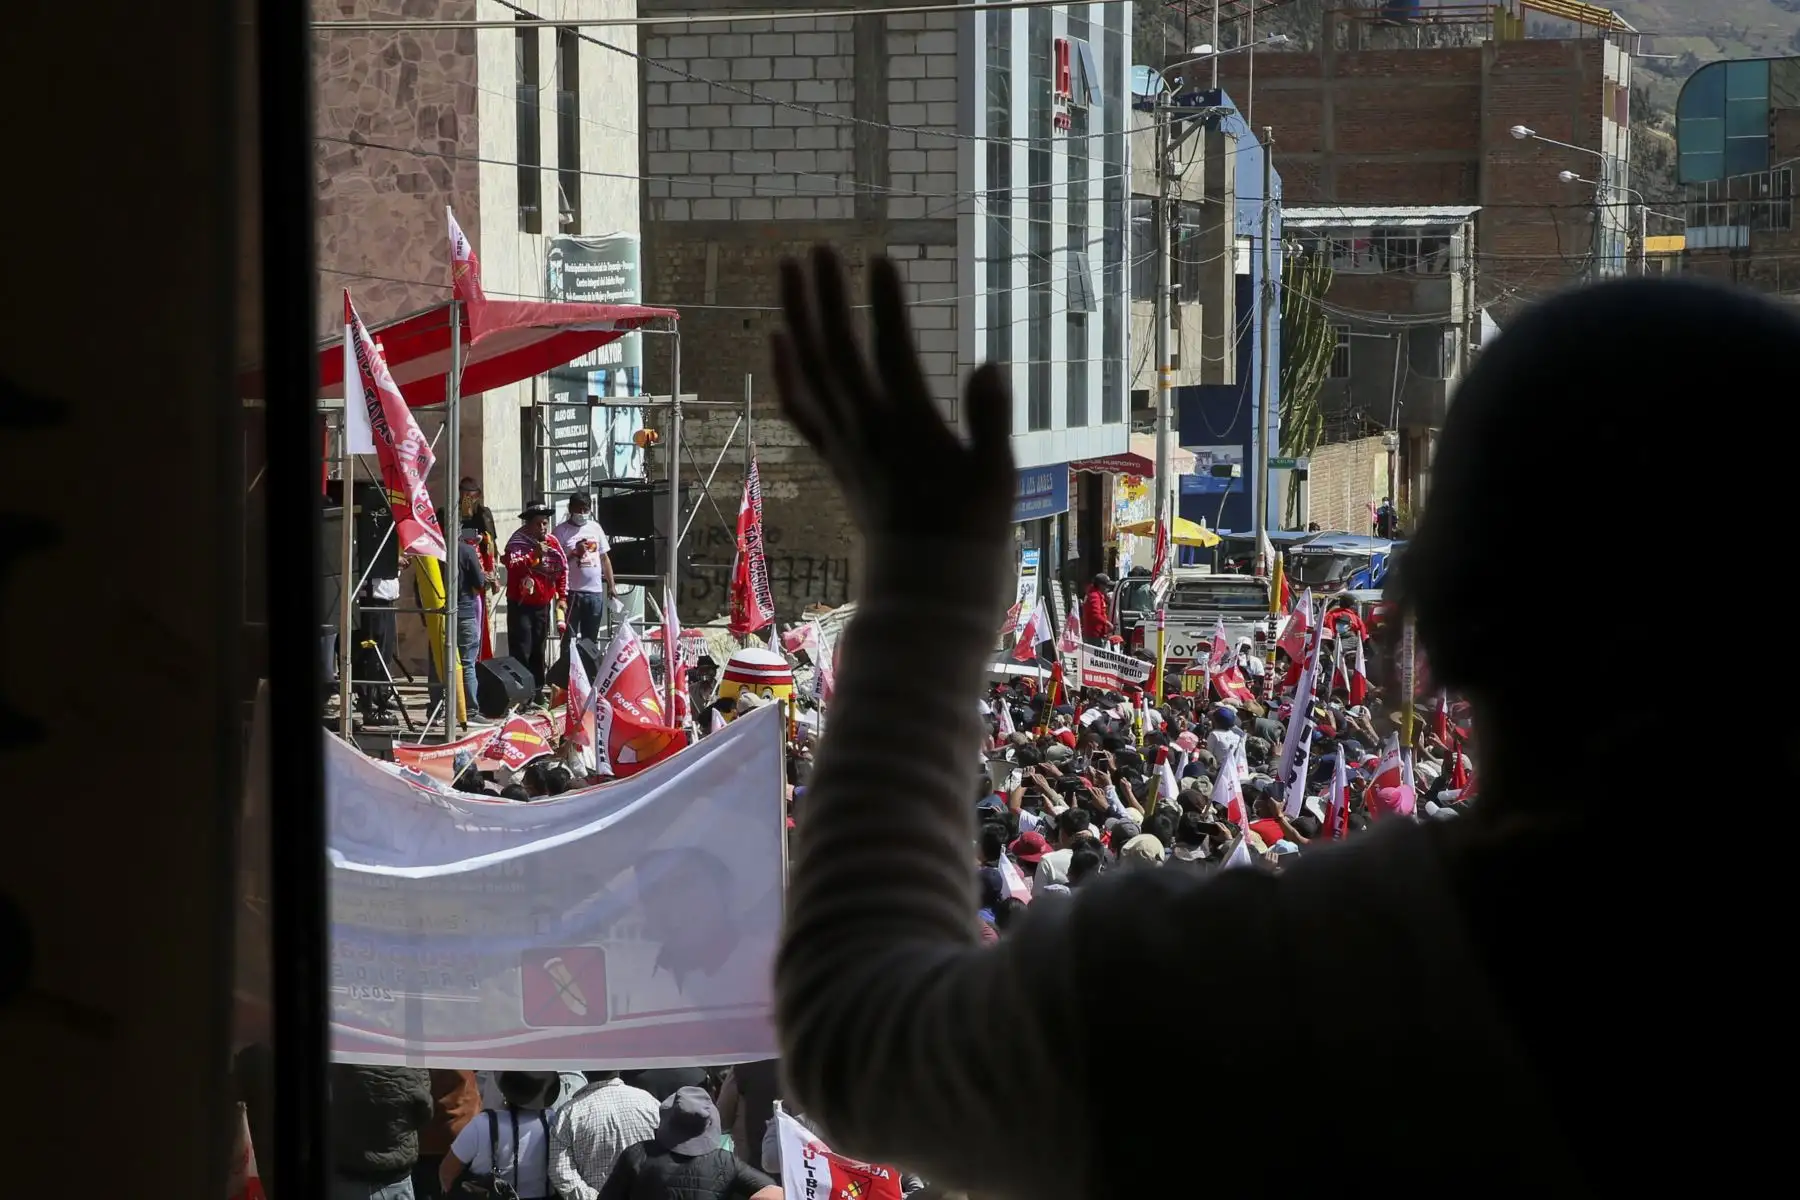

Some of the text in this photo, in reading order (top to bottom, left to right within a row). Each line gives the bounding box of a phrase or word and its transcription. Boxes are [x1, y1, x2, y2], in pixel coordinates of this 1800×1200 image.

[598, 342, 622, 365] MAYOR
[1267, 612, 1277, 652] LIBRE
[1093, 649, 1140, 668] DISTRITAL DE
[613, 692, 640, 716] Pedro
